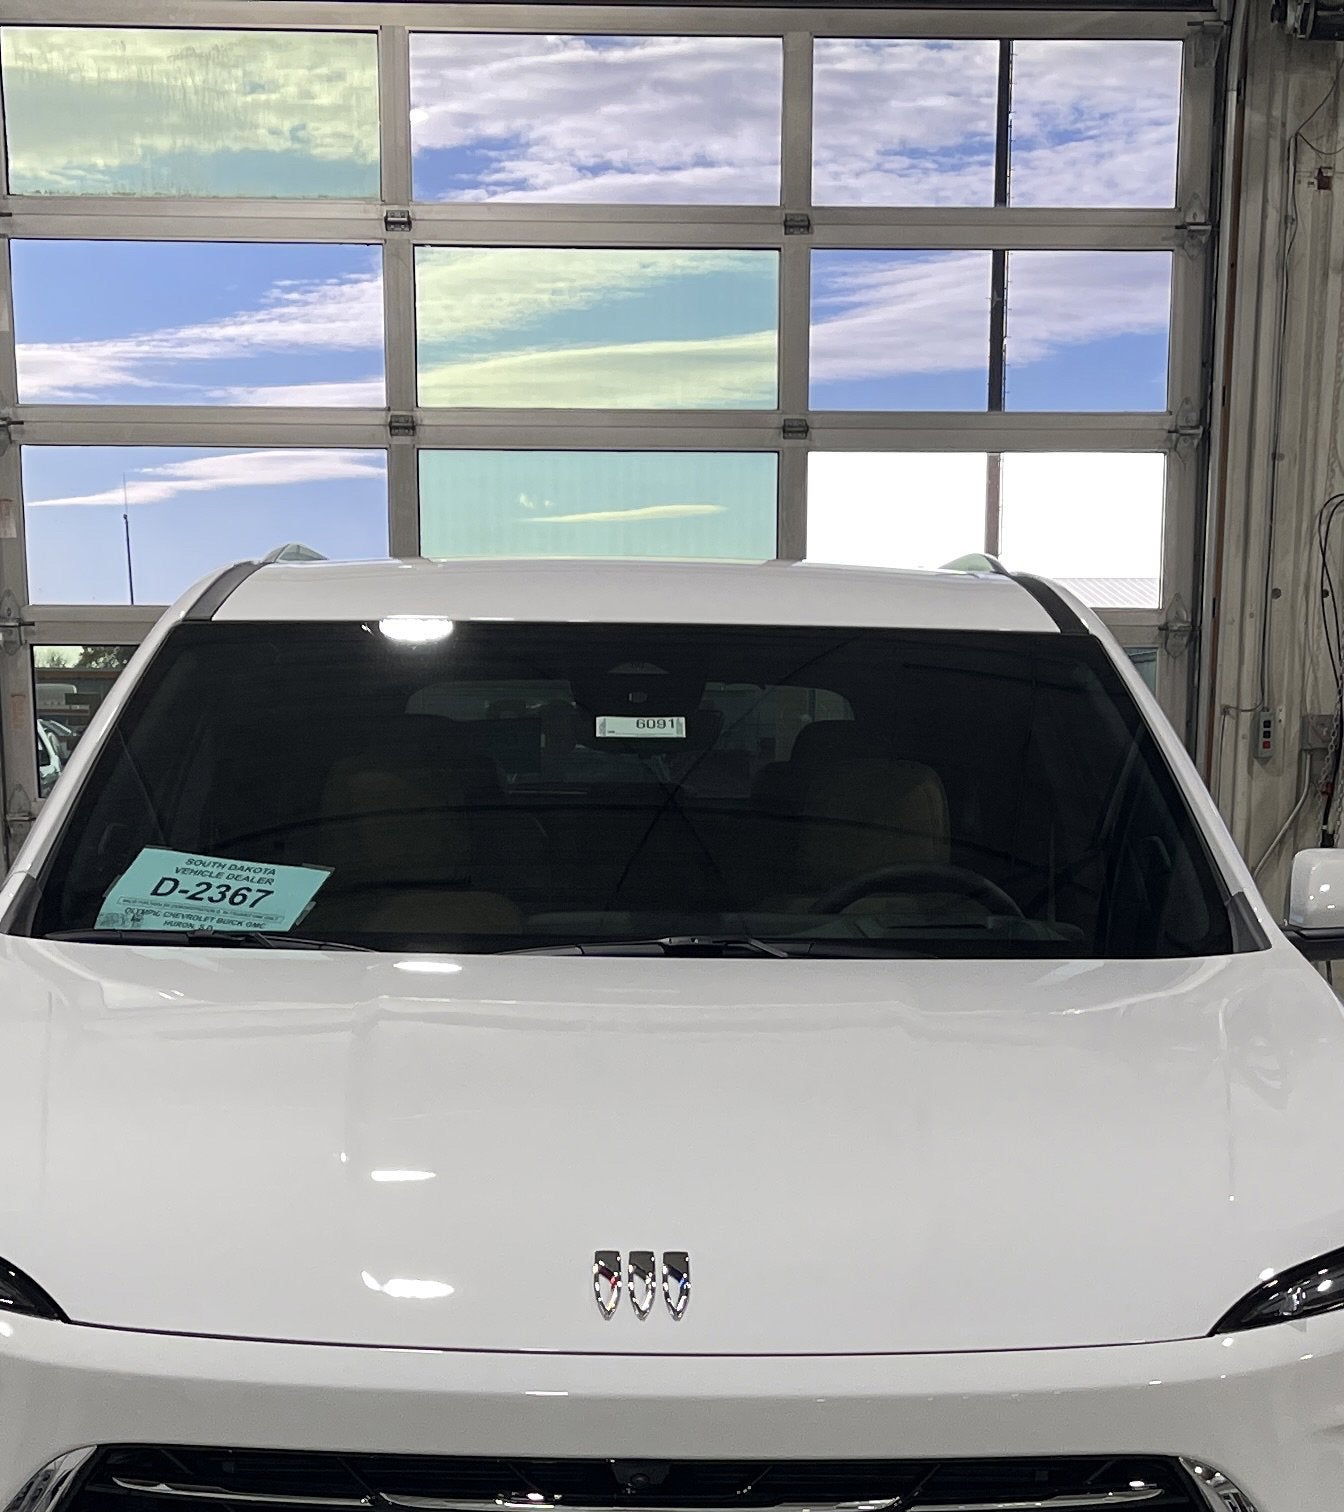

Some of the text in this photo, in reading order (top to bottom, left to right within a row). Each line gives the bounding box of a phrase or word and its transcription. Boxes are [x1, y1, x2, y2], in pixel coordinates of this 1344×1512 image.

[635, 718, 675, 729] 6091
[174, 867, 275, 886] VEHICLE DEALER
[185, 857, 276, 877] SOUTH DAKOTA
[150, 876, 275, 909] D-2367
[163, 911, 216, 923] CHEVROLET
[216, 917, 245, 927] BUICK
